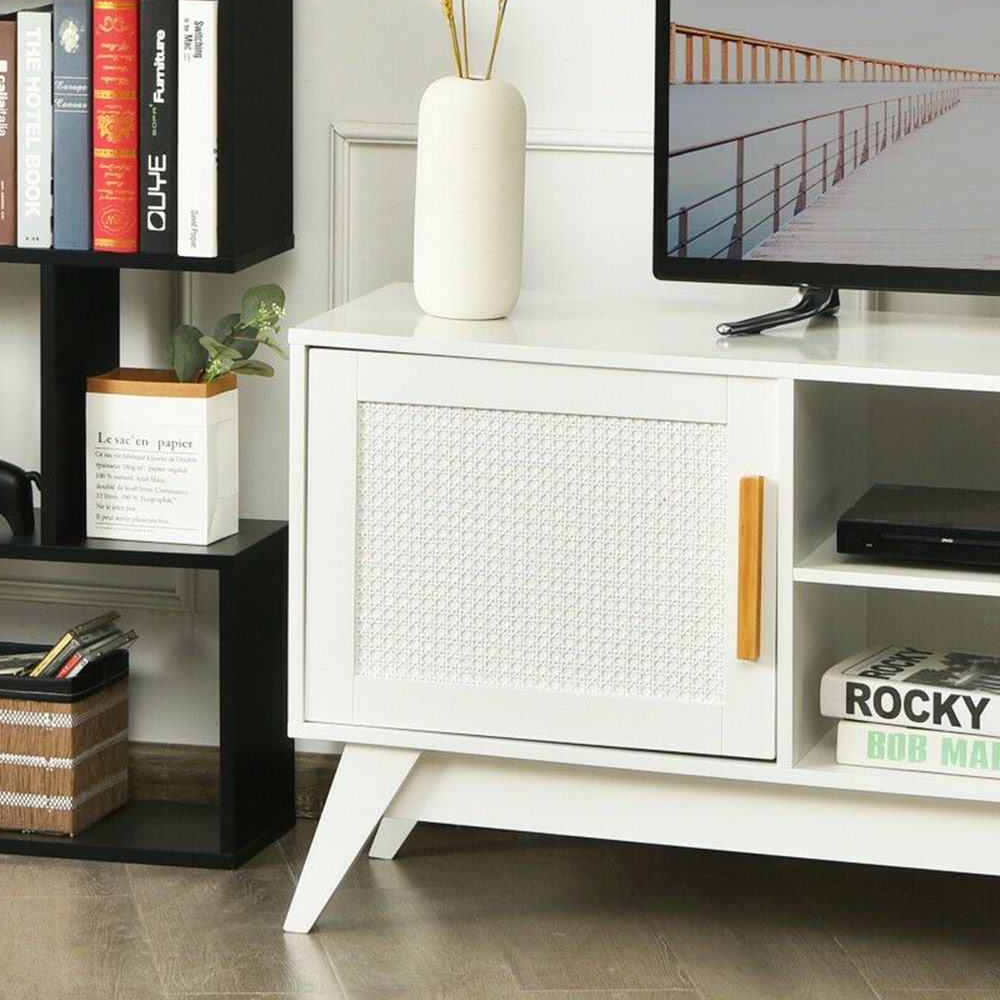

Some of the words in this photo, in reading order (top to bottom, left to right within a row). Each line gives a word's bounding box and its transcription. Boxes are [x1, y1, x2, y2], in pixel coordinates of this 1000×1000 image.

[25, 27, 41, 71] THE
[184, 34, 192, 50] Mac
[193, 20, 204, 58] Switching
[153, 30, 166, 103] Furniture
[25, 76, 41, 148] HOTEL
[24, 153, 41, 218] BOOK
[190, 210, 198, 227] David
[190, 228, 198, 248] Pogue
[98, 432, 112, 444] Le
[158, 438, 192, 451] papier
[858, 647, 934, 680] ROCKY
[845, 681, 990, 730] ROCKY
[867, 730, 926, 763] BOB
